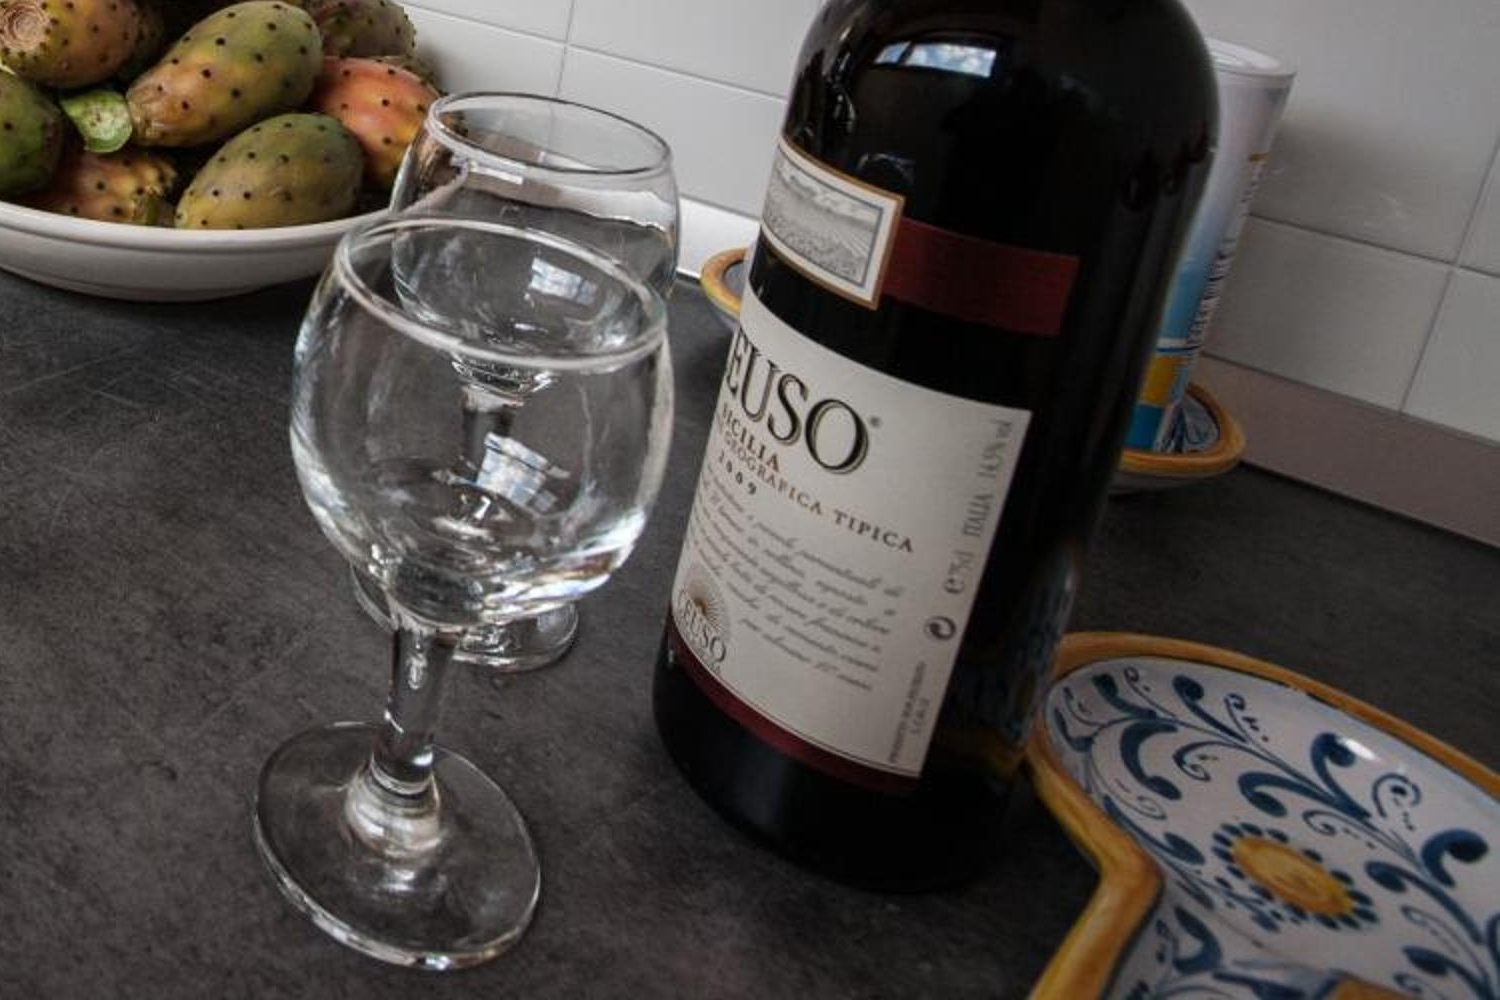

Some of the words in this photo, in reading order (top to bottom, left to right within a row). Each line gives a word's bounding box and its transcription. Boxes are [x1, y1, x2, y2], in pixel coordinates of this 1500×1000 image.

[725, 327, 869, 475] EUSO
[724, 430, 824, 516] GEOGRAFICA
[833, 507, 914, 553] TIPICA
[961, 494, 994, 537] ITALIA
